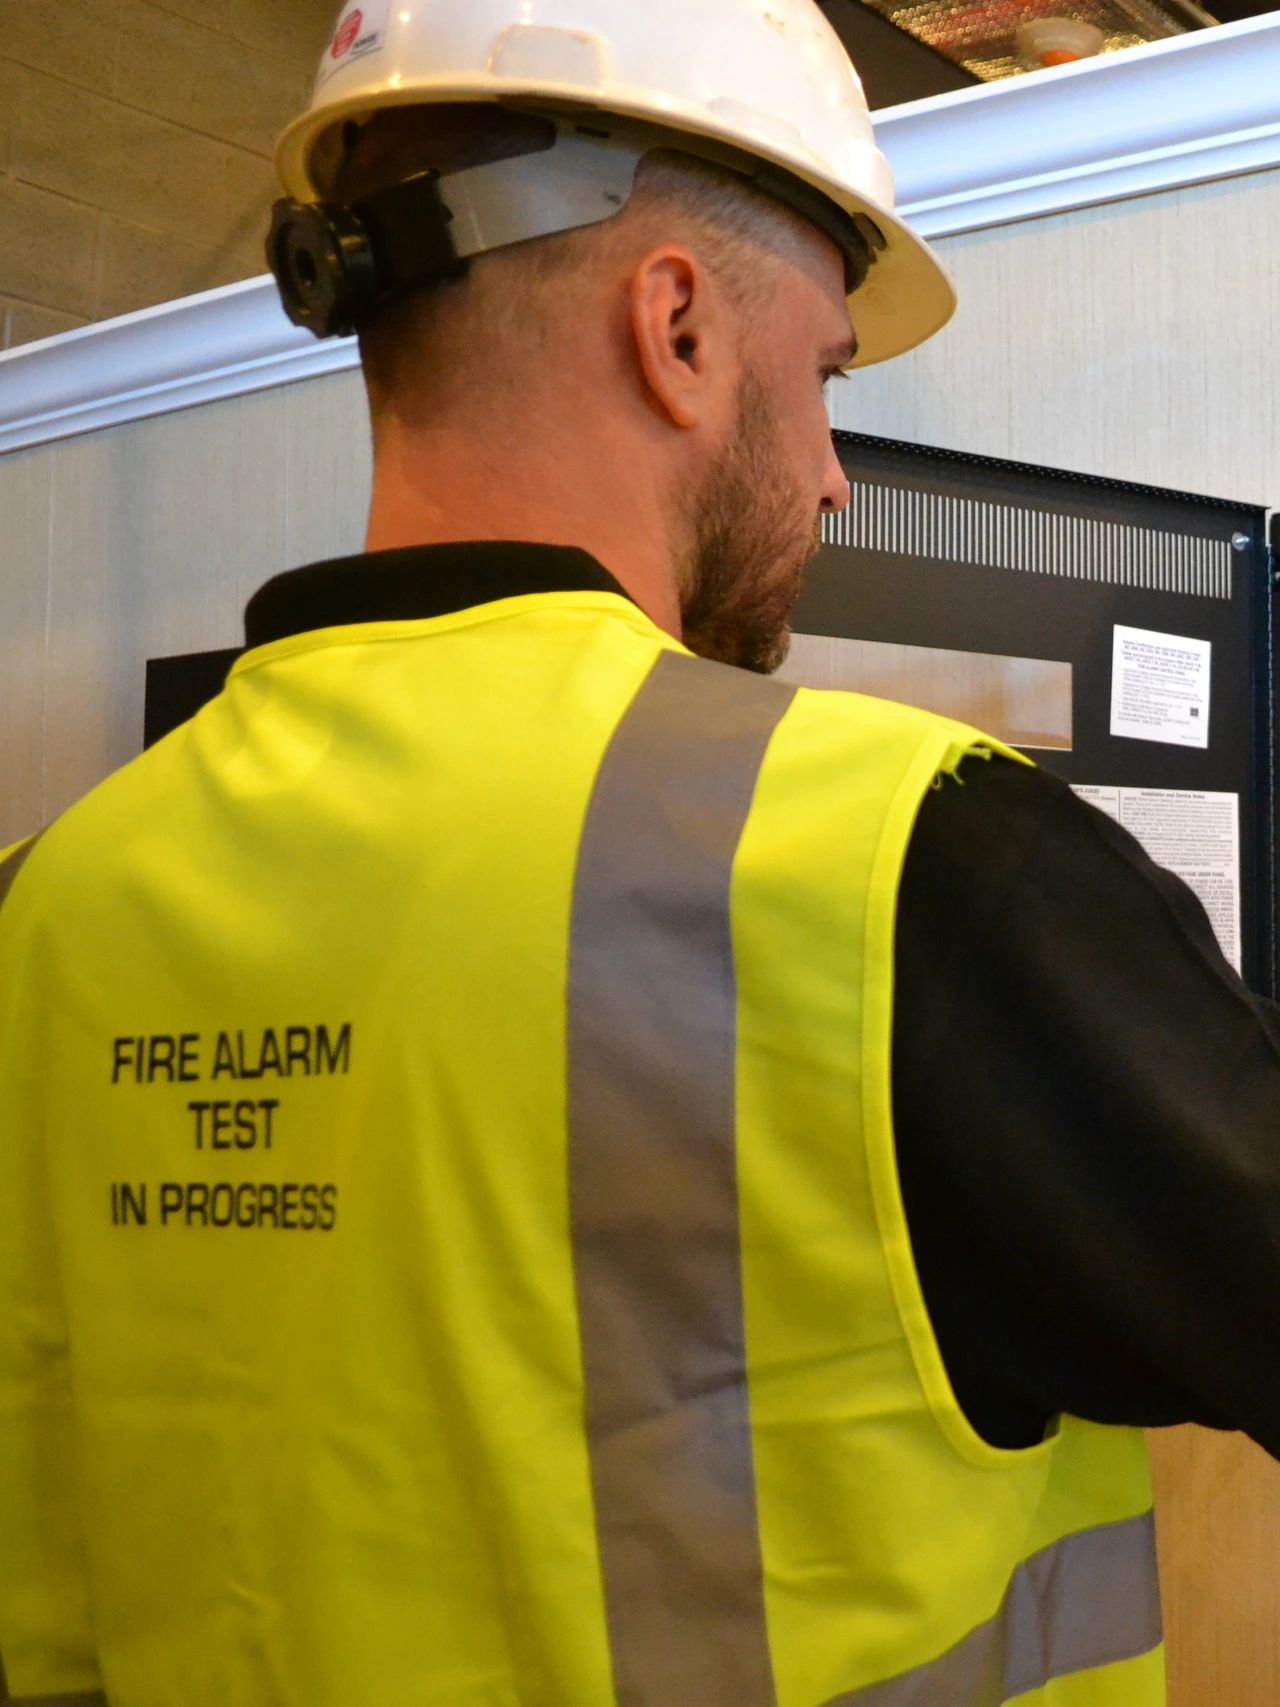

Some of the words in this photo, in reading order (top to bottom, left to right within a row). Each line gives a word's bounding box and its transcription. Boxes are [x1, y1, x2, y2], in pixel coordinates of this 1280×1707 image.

[112, 1033, 200, 1084] FIRE
[211, 1022, 352, 1080] ALARM
[188, 1098, 279, 1150] TEST
[111, 1182, 147, 1226] IN
[160, 1182, 338, 1231] PROGRESS
